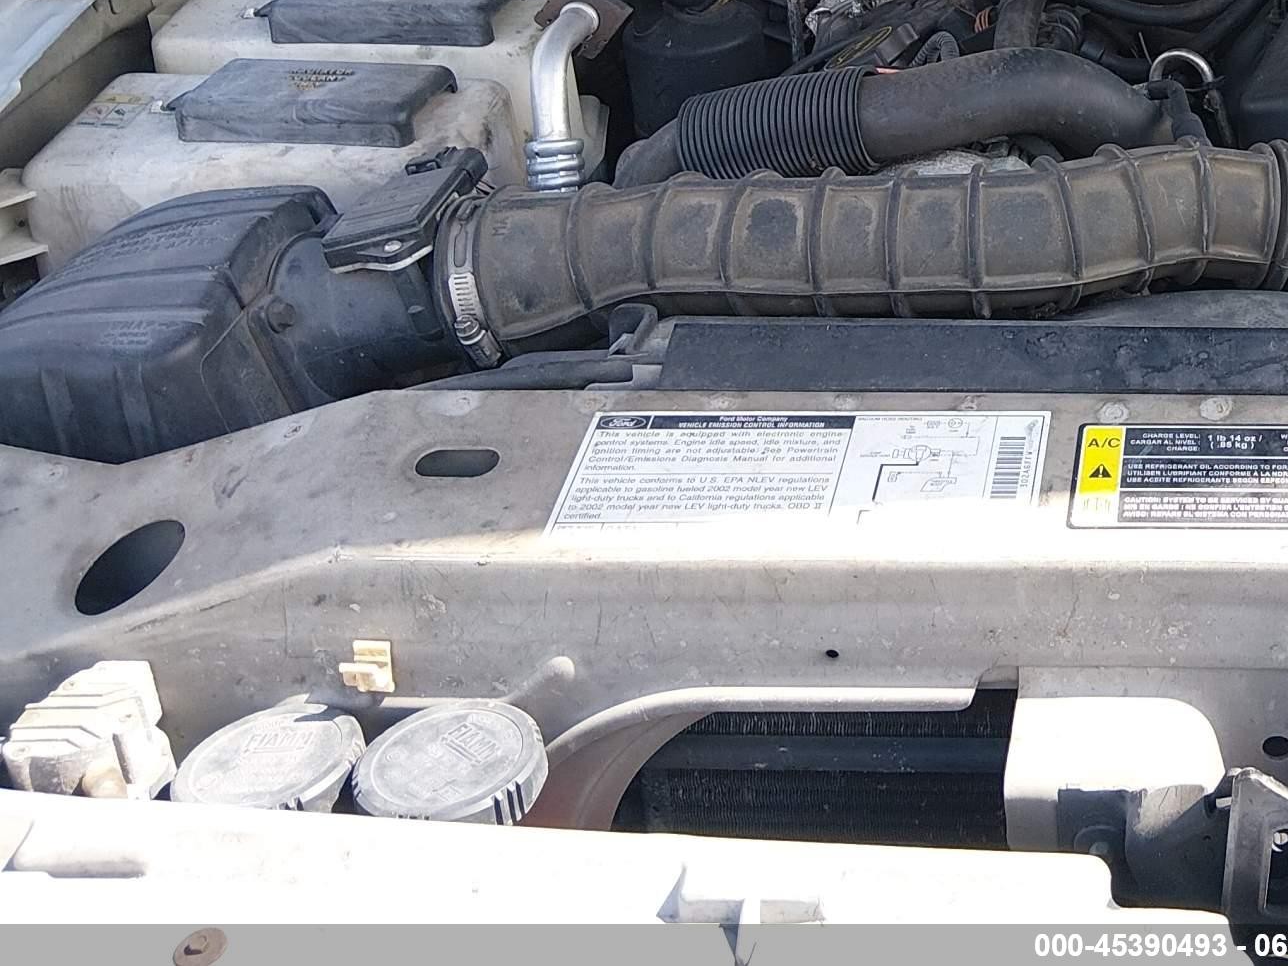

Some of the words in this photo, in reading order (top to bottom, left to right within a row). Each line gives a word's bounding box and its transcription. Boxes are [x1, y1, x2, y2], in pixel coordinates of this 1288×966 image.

[609, 418, 637, 428] Ford
[680, 430, 726, 439] equipped
[1208, 434, 1213, 442] 1
[1216, 434, 1226, 442] lb
[1230, 434, 1242, 442] 14
[1244, 434, 1257, 442] oz
[1258, 434, 1263, 442] /
[673, 439, 706, 447] Engine
[1088, 437, 1120, 448] A/C
[1235, 442, 1248, 450] kg
[580, 476, 599, 484] This
[603, 476, 636, 484] vehicle
[640, 476, 682, 484] conforms
[686, 476, 696, 484] to
[724, 476, 744, 484] EPA
[747, 476, 776, 484] NLEV
[778, 476, 830, 484] regulations
[575, 486, 622, 494] applicable
[636, 486, 674, 494] gasoline
[571, 494, 614, 502] light-duty
[725, 494, 776, 502] regulations
[778, 494, 824, 502] applicable
[638, 503, 658, 511] year
[708, 503, 750, 511] light-duty
[245, 729, 316, 747] FIAMM
[448, 722, 498, 762] FIAMM
